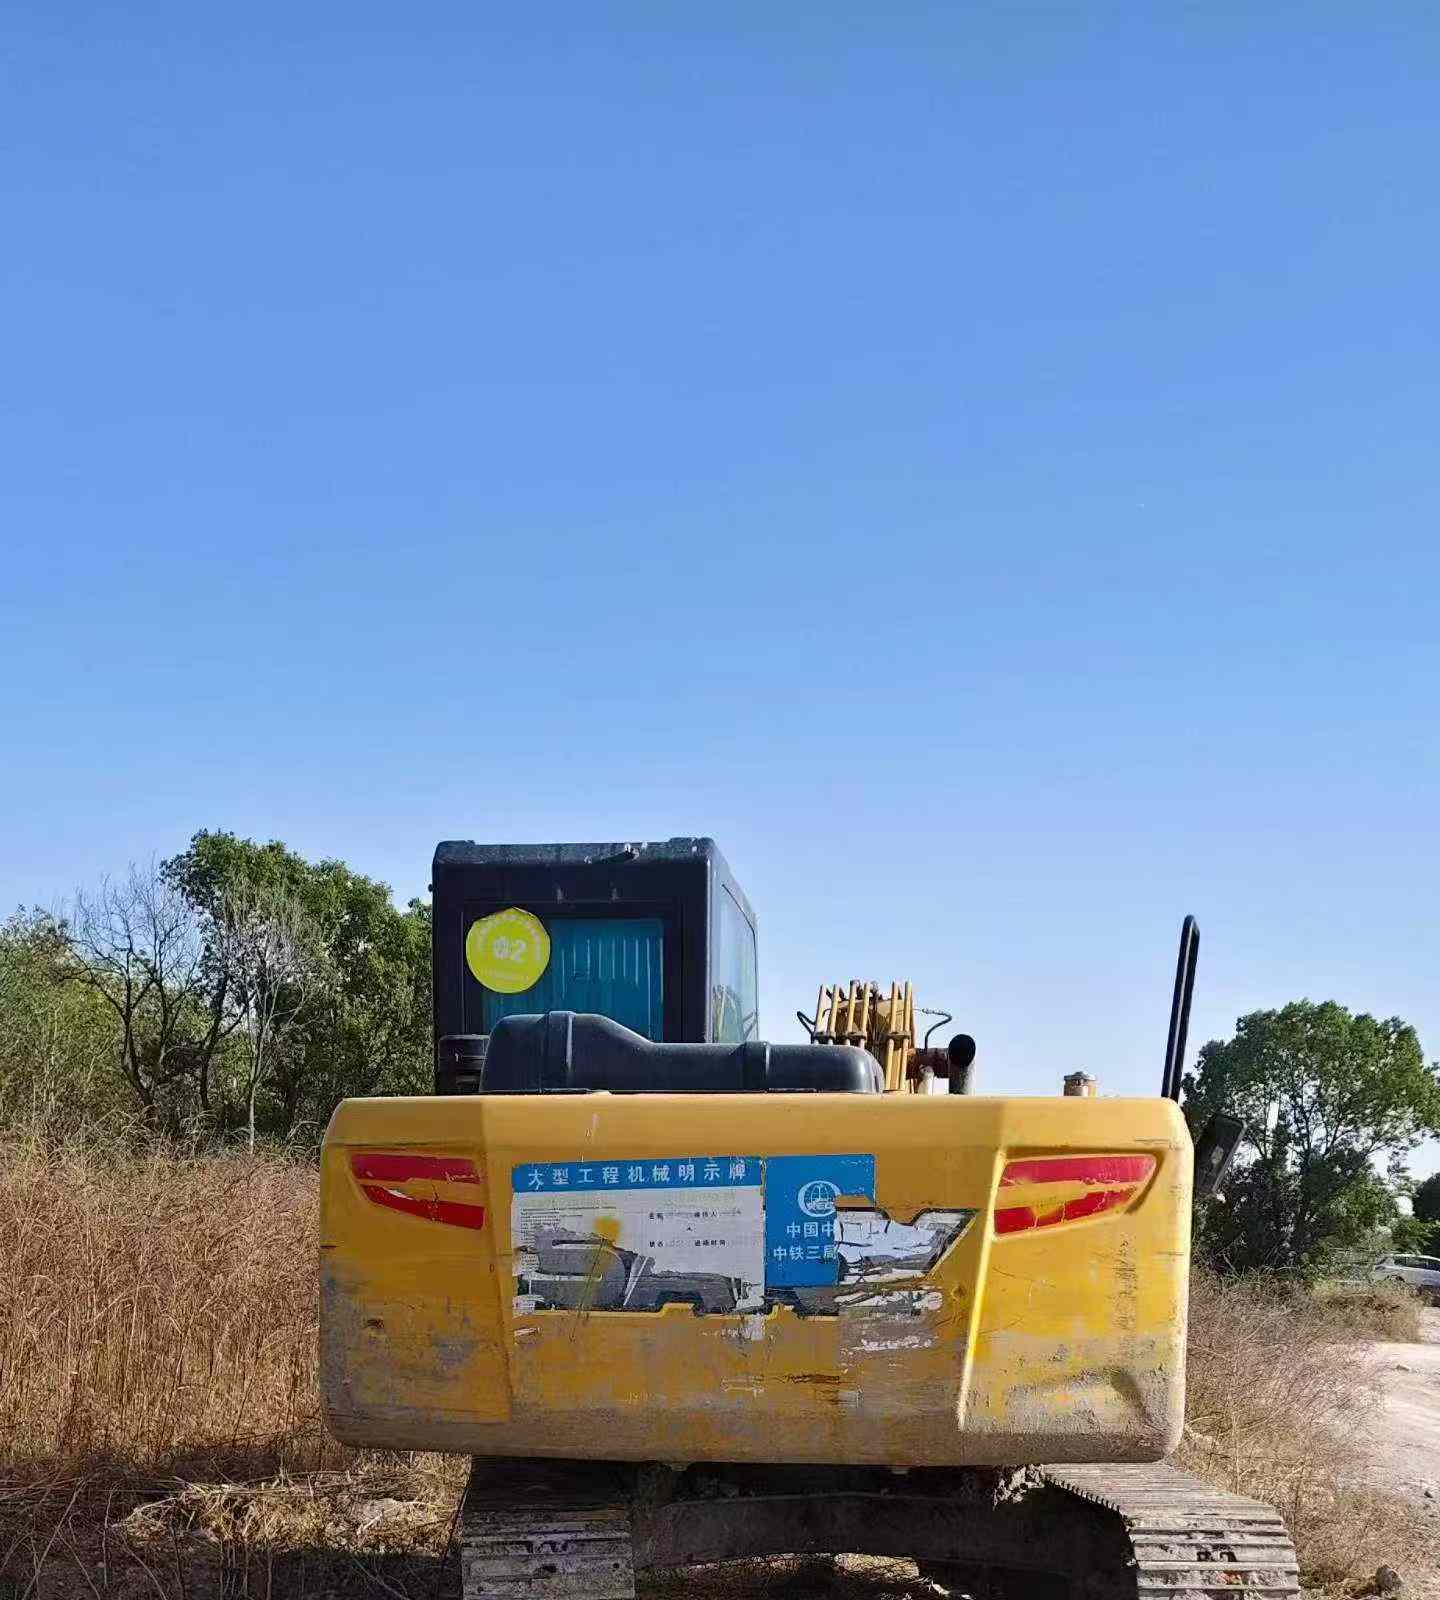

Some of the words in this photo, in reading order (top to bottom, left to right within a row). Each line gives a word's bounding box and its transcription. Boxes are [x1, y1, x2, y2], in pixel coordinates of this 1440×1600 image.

[528, 1162, 747, 1190] 大型工程机械明示牌
[786, 1221, 834, 1239] 中国中
[773, 1245, 838, 1262] 中铁三局
